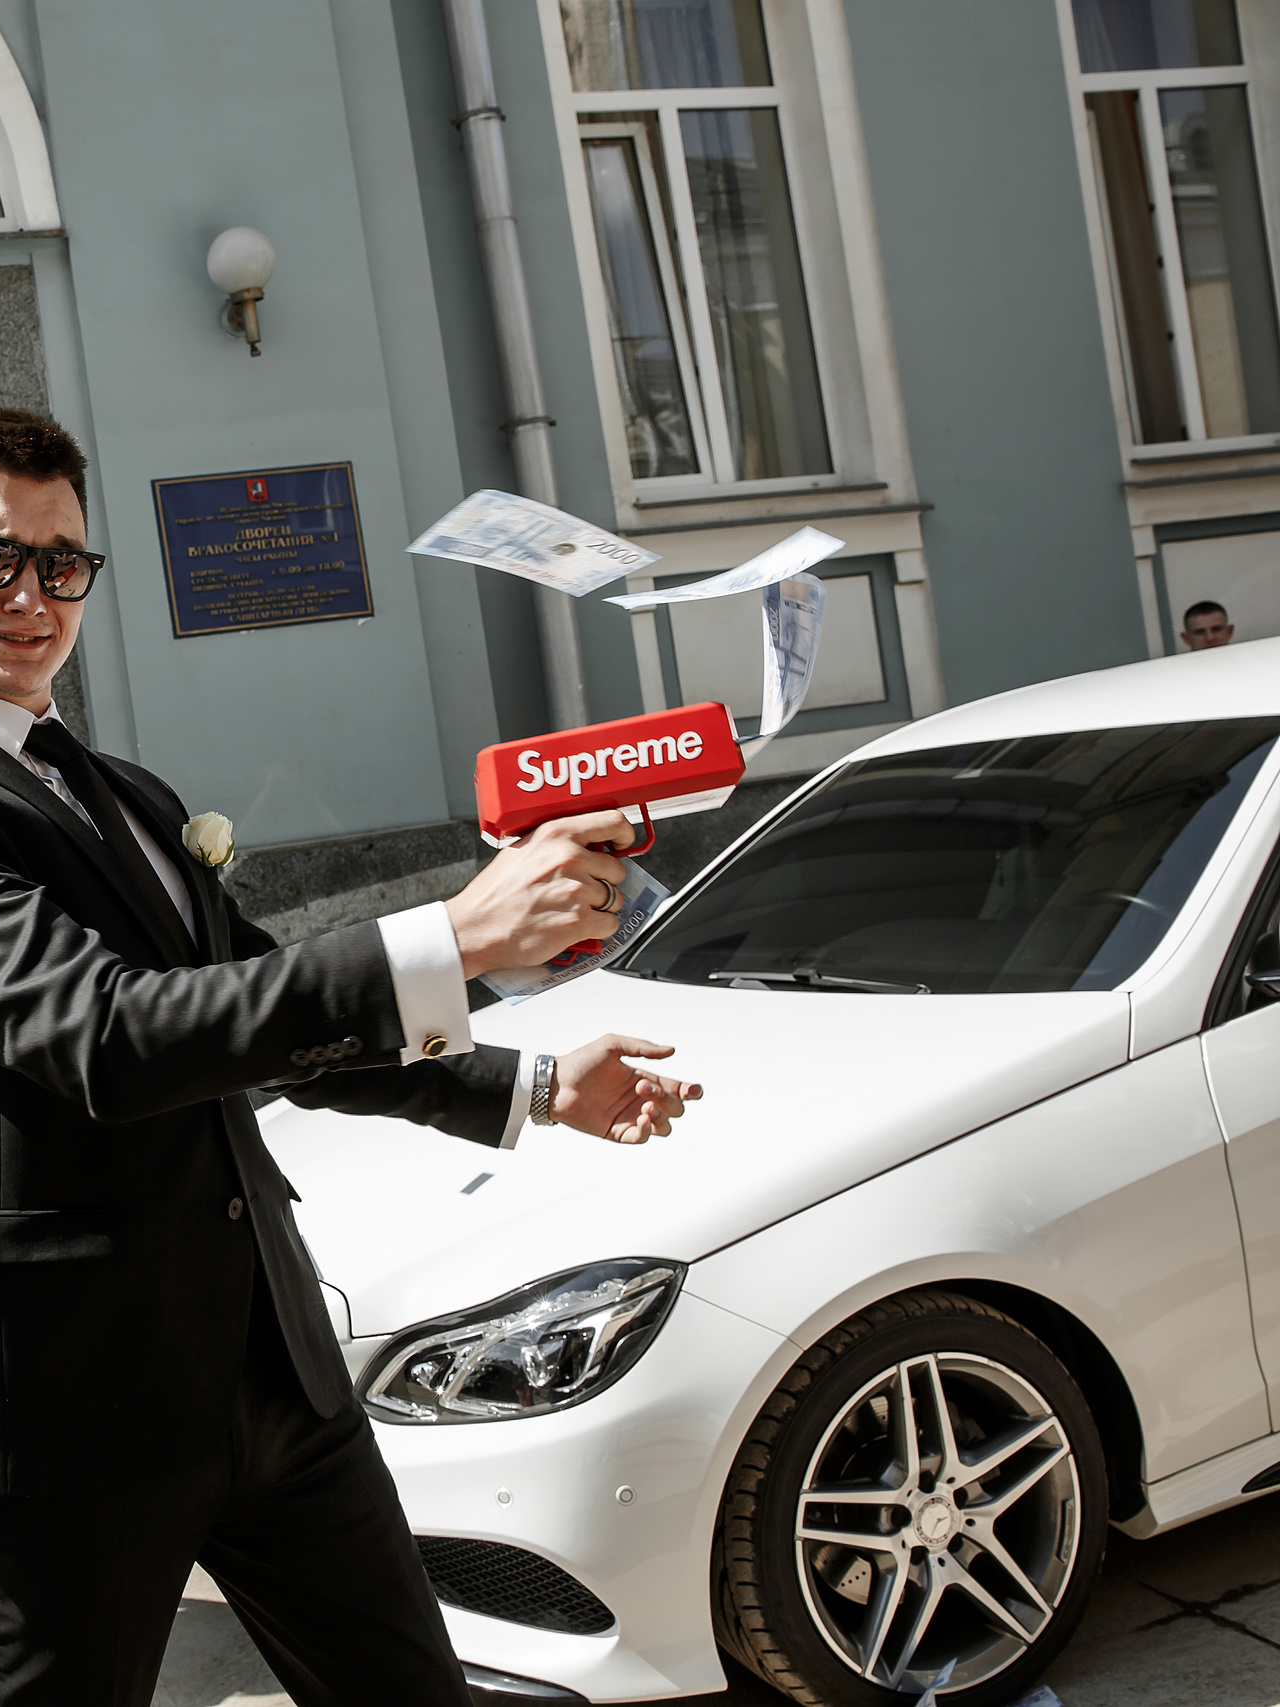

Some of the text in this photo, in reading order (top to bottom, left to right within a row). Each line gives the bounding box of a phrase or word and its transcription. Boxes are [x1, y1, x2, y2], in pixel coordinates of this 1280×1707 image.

[235, 525, 292, 540] ДВОРЕЦ
[188, 534, 314, 557] БРАКОСОЧЕТАНИЯ
[587, 540, 642, 565] 2000
[517, 731, 703, 795] Supreme
[620, 909, 646, 941] 2000
